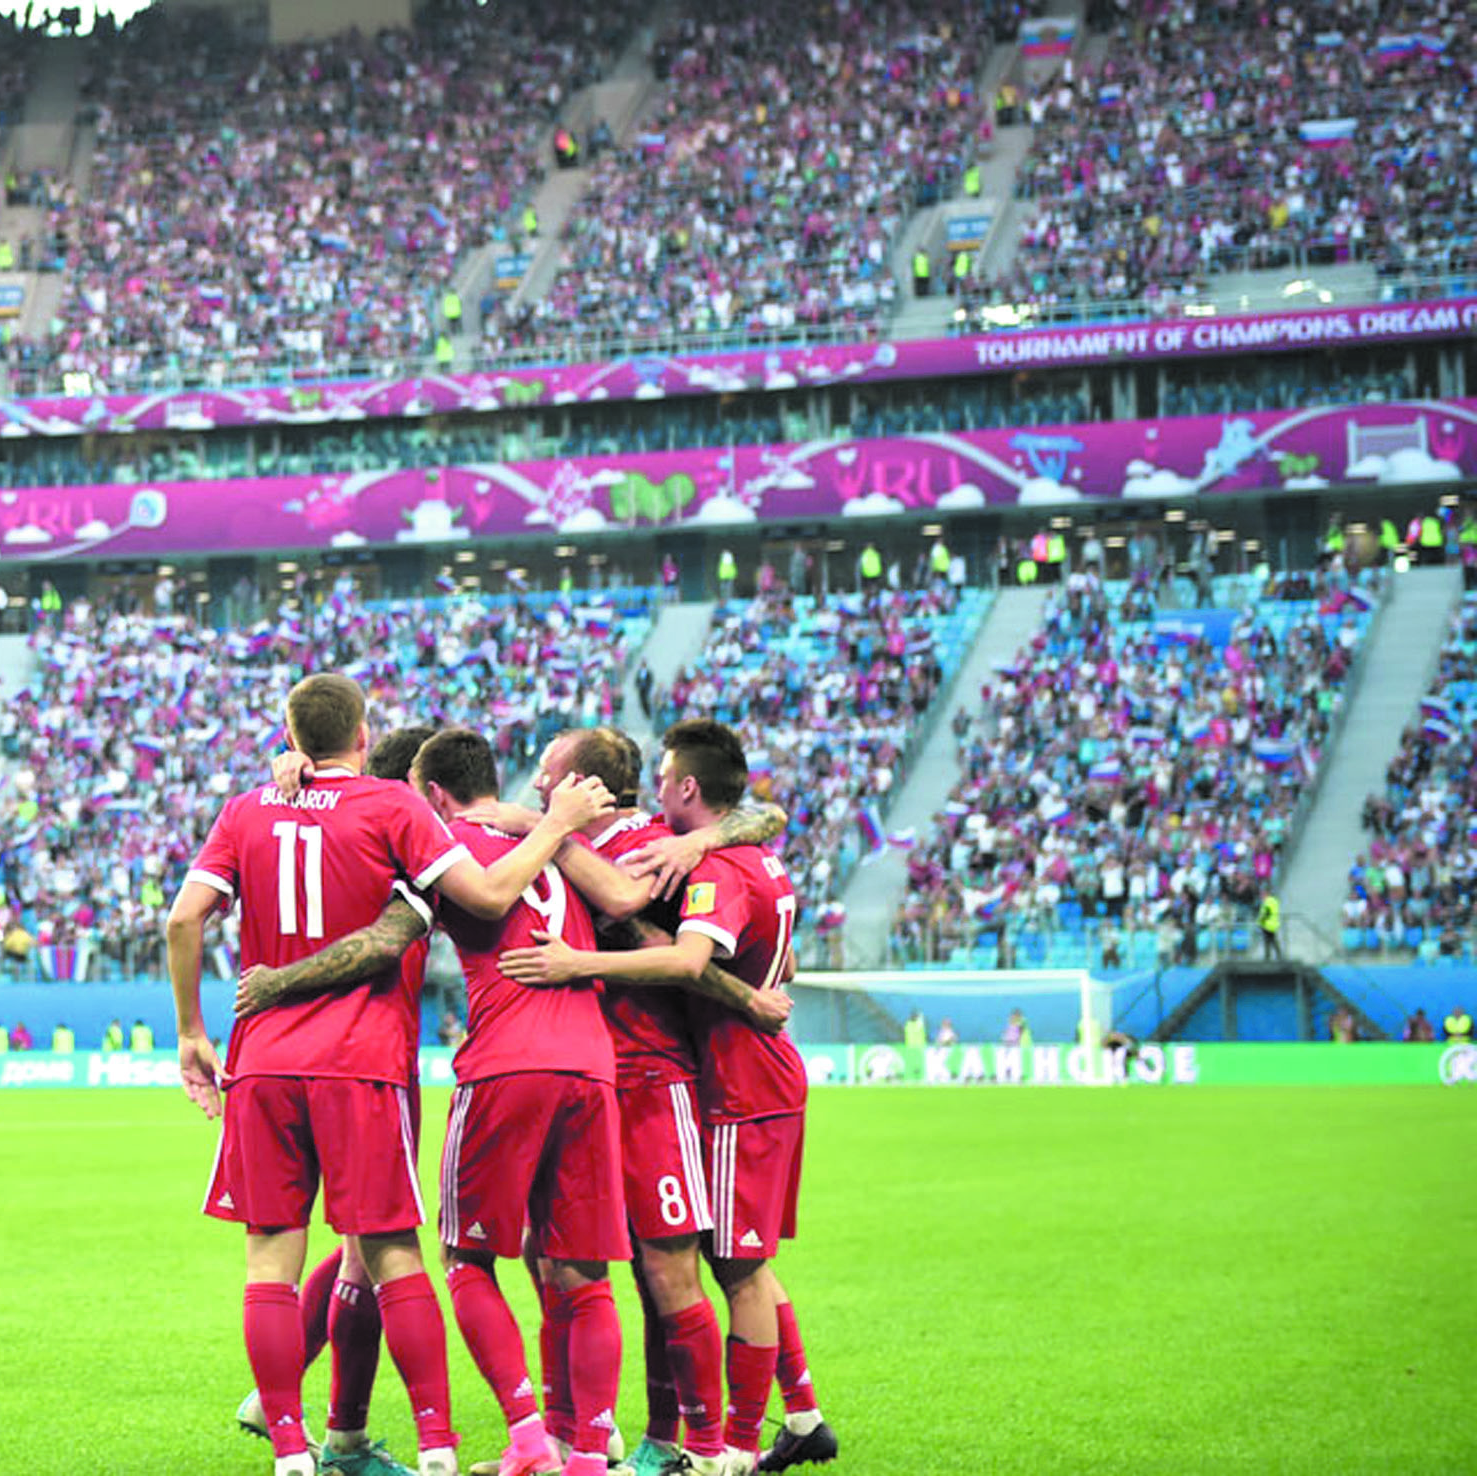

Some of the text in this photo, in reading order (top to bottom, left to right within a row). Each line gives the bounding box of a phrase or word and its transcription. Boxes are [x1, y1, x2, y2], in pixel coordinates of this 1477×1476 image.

[1359, 306, 1459, 335] DREAM
[273, 821, 323, 939] 11
[521, 862, 567, 937] 9
[657, 1175, 688, 1226] 8
